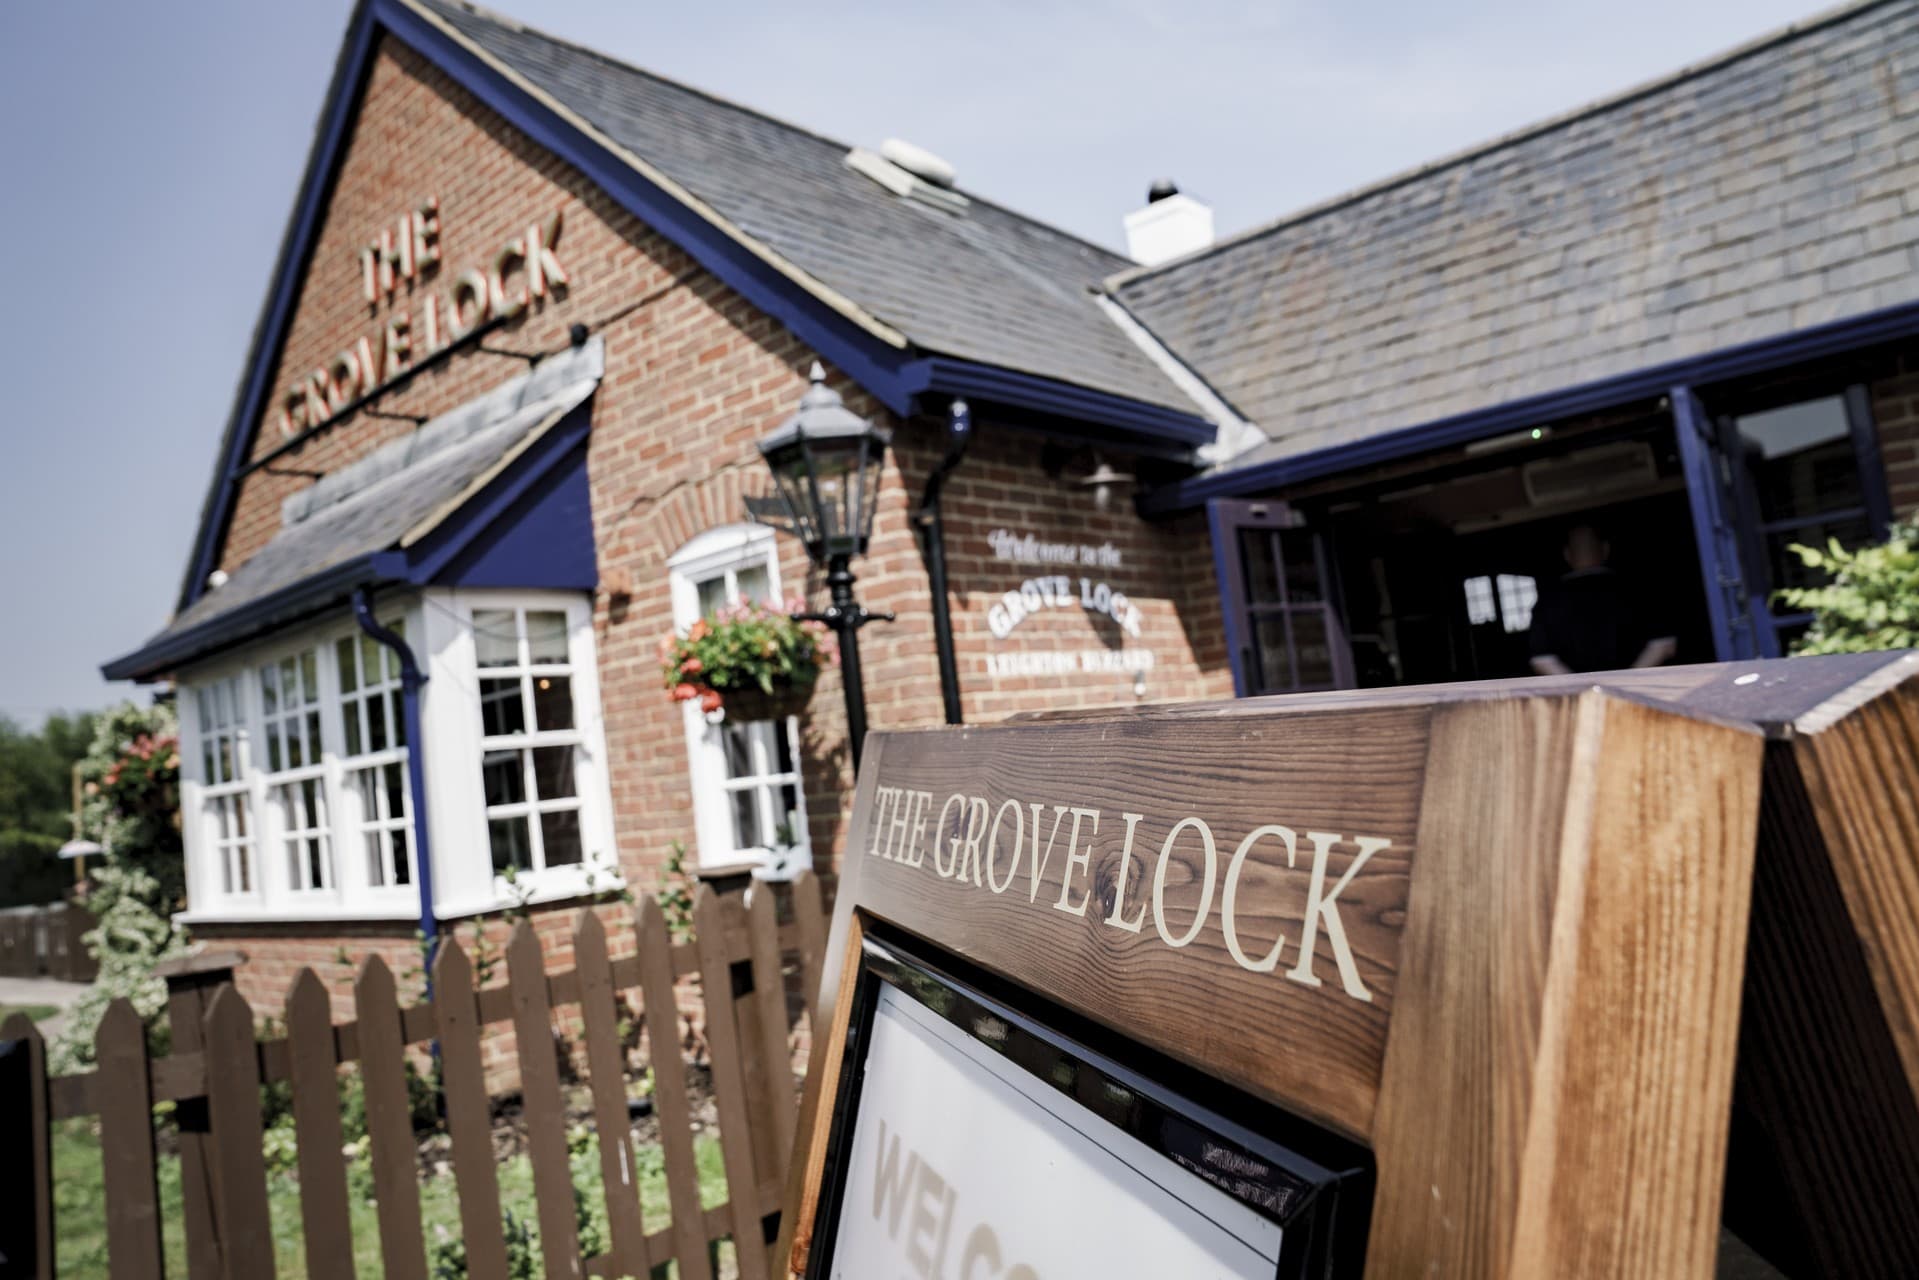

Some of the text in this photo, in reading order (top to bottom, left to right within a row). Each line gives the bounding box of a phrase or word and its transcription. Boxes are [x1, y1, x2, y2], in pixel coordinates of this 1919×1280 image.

[278, 206, 570, 440] GROVE LOCK
[359, 196, 441, 303] THE
[988, 575, 1144, 640] GROVE LOCK
[869, 784, 1392, 1001] THE GROVE LOCK
[872, 1117, 1042, 1280] WELC
